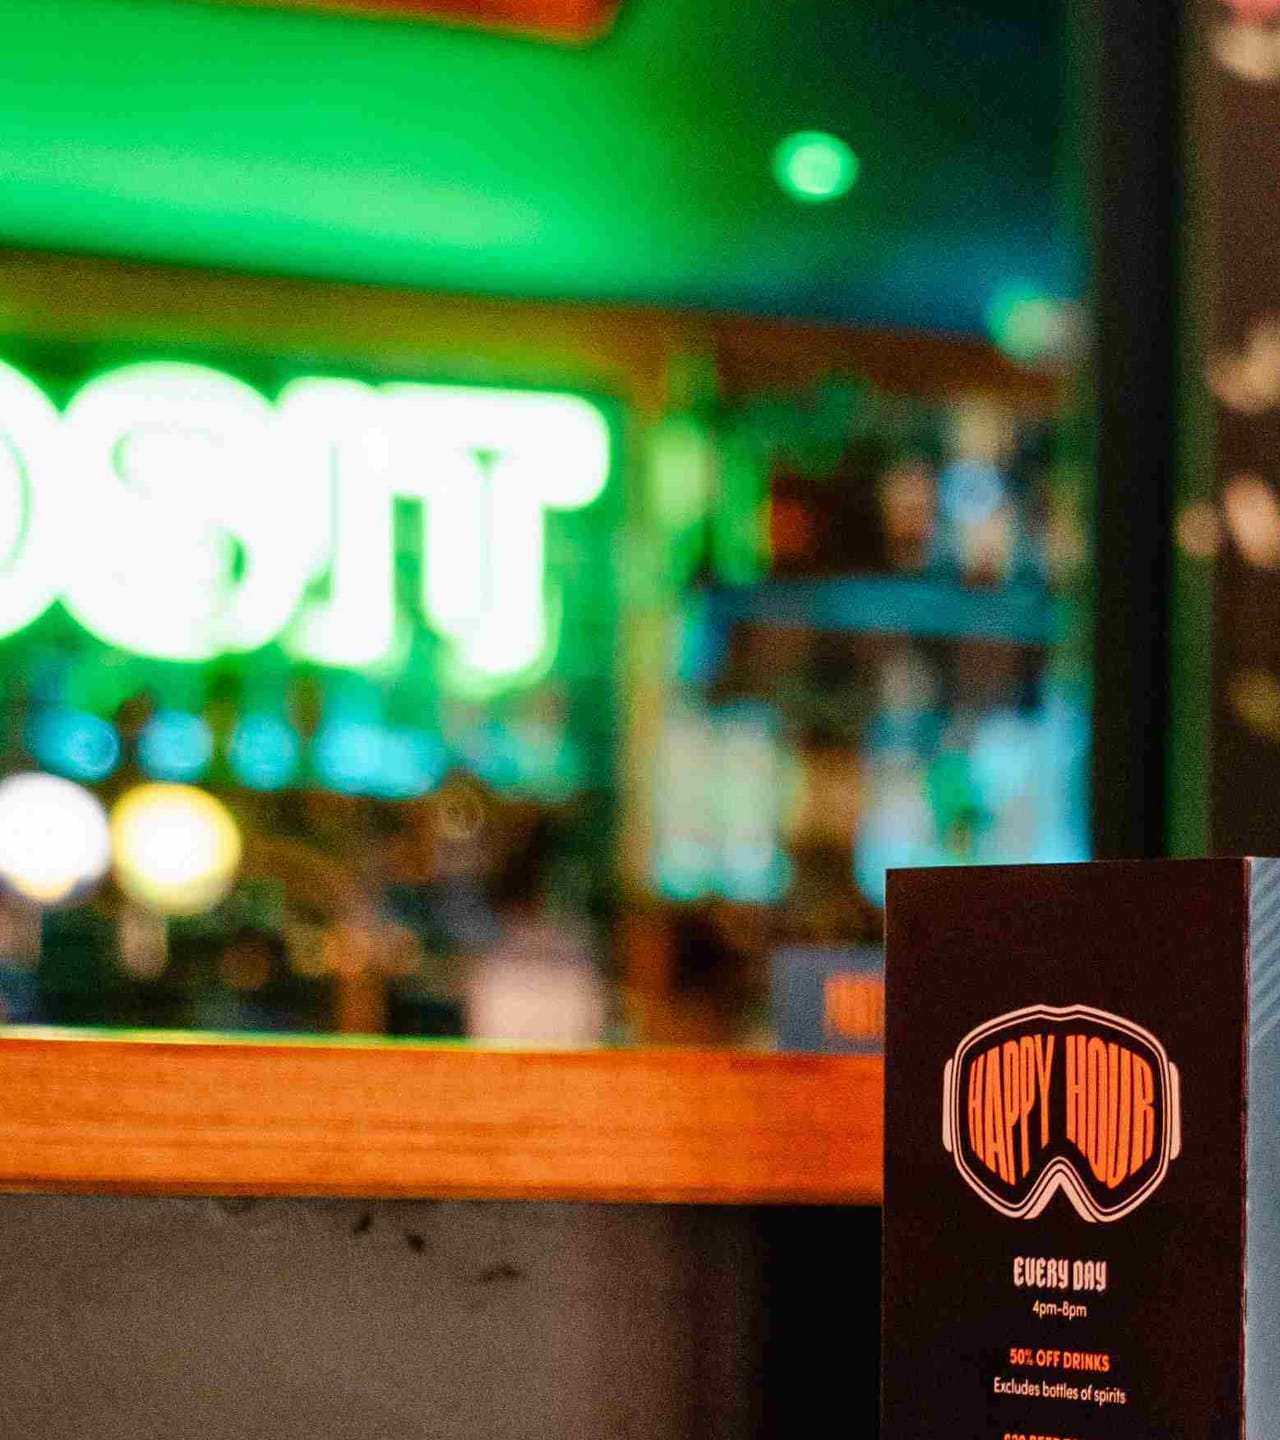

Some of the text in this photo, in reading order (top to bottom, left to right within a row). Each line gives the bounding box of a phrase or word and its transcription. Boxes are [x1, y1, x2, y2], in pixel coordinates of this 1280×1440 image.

[968, 1033, 1155, 1189] HAPPY HOUR
[1013, 1256, 1107, 1292] EVERY DAY
[1032, 1300, 1087, 1320] 4pm-8pm
[1010, 1348, 1110, 1372] 50% OFF DRINKS
[993, 1376, 1127, 1406] Excludes bottles of spirits
